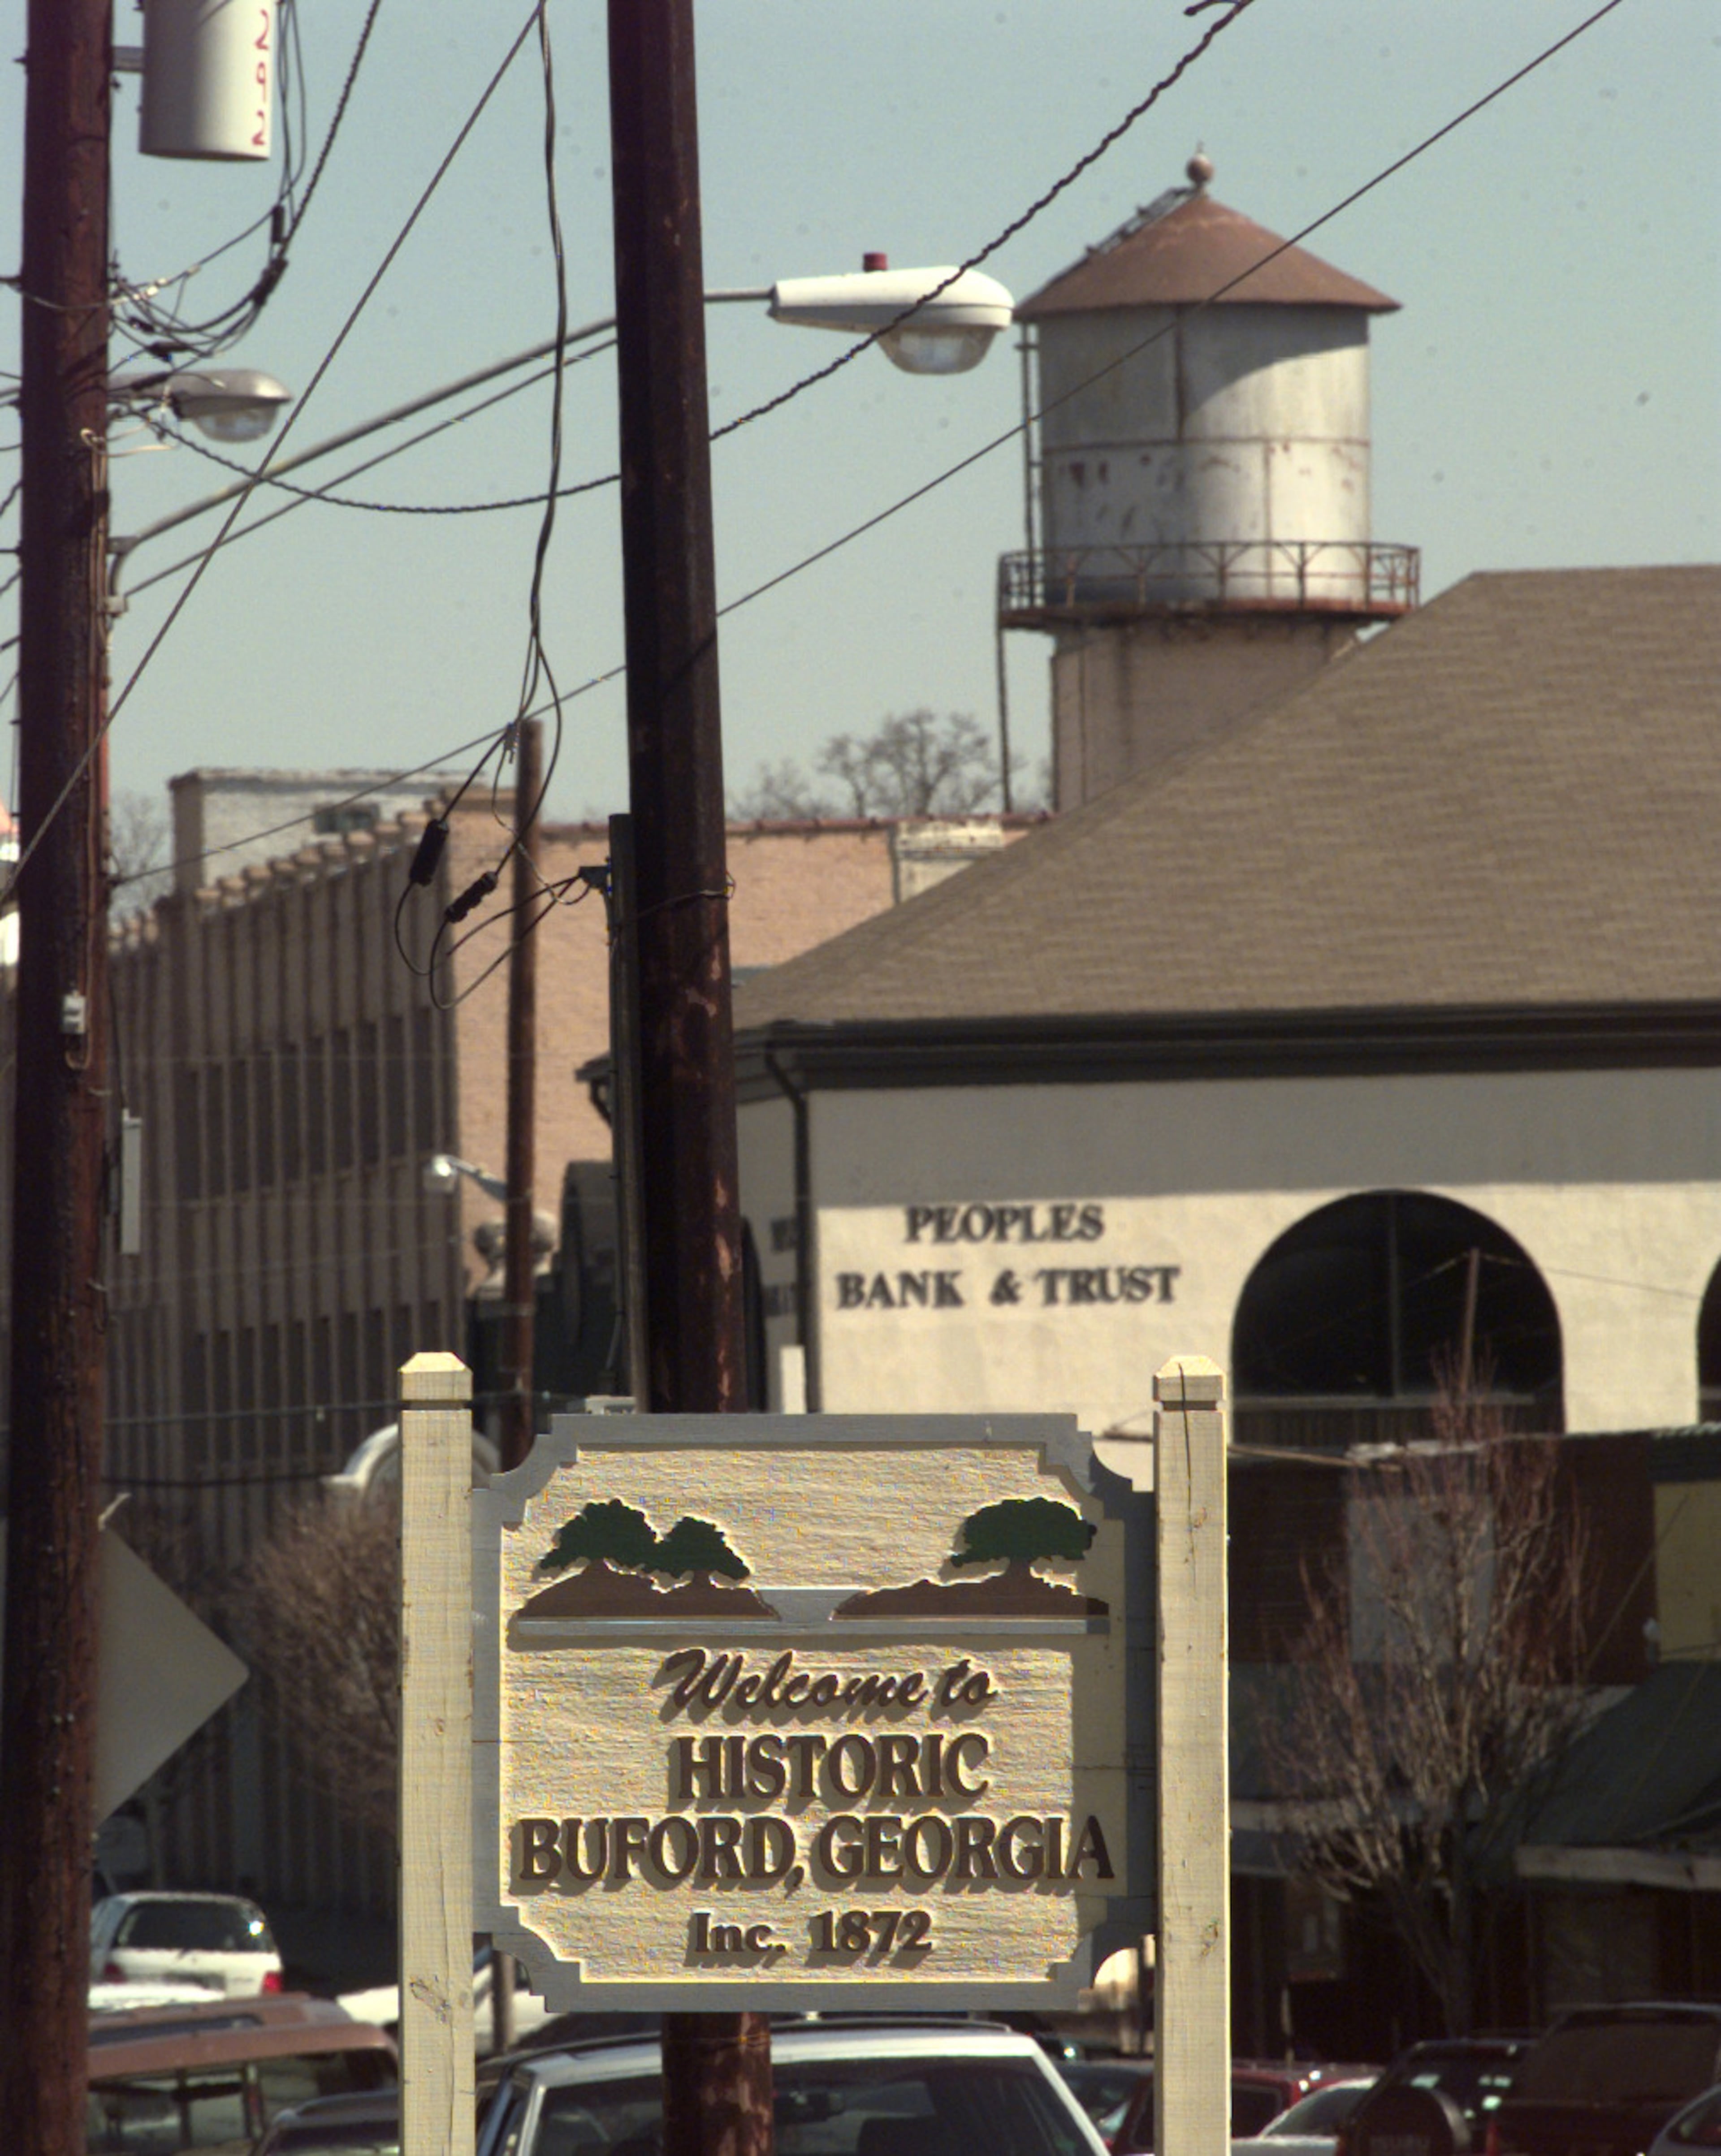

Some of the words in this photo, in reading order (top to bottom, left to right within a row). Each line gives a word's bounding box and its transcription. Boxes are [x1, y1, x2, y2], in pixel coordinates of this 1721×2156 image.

[904, 1204, 1105, 1244] PEOPLES
[835, 1271, 965, 1309] BANK
[990, 1269, 1021, 1306] &
[1036, 1266, 1180, 1305] TRUST
[660, 1648, 928, 1708] Welcome
[940, 1659, 998, 1708] to
[678, 1733, 989, 1799] HISTORIC
[518, 1816, 804, 1900] BUFORD,
[818, 1815, 1115, 1882] GEORGIA
[694, 1913, 787, 1954] Inc.
[816, 1911, 933, 1953] 1872
